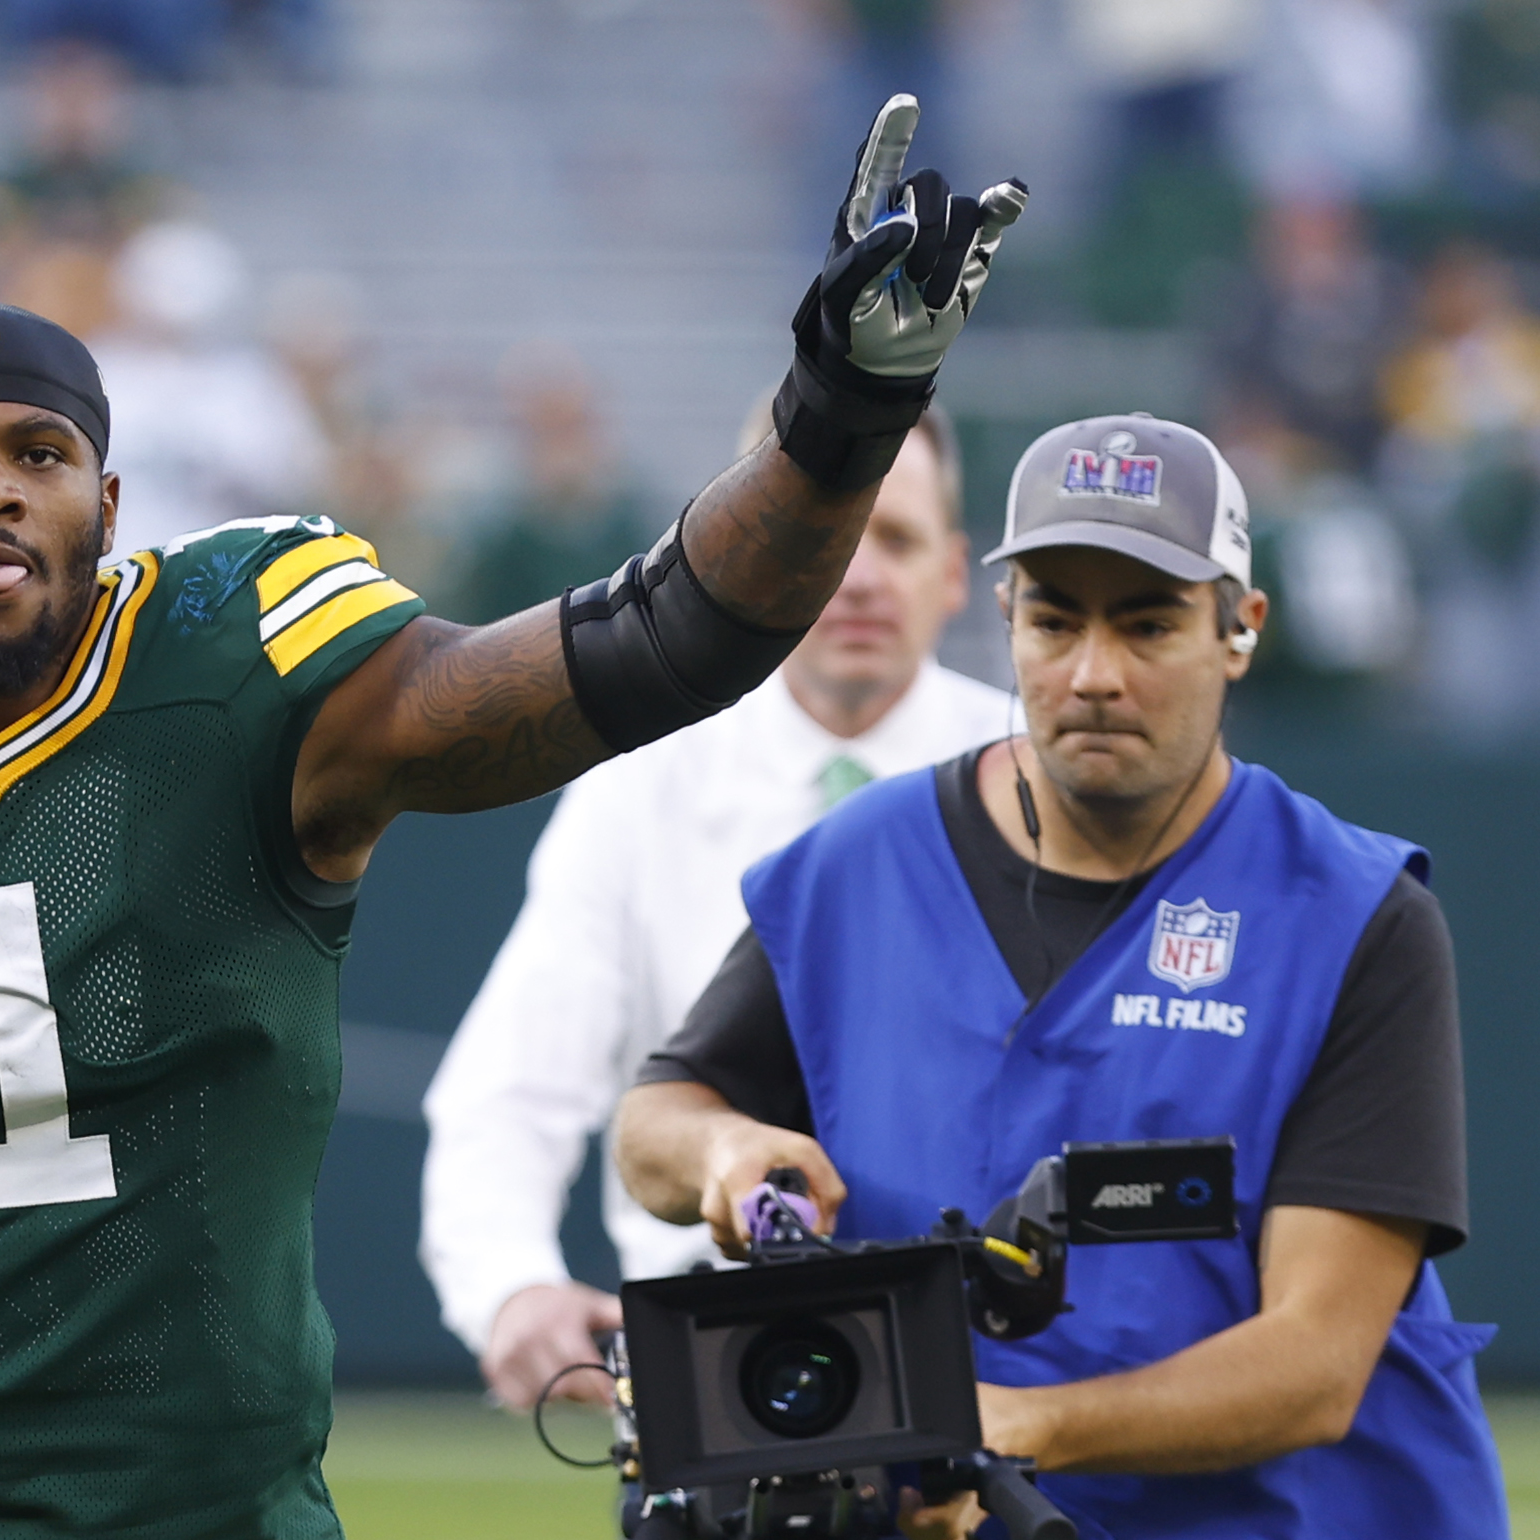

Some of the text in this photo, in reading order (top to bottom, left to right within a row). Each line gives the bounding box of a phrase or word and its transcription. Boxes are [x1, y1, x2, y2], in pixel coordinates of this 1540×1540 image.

[1160, 935, 1221, 976] NFL
[1111, 993, 1248, 1038] NFL FILMS
